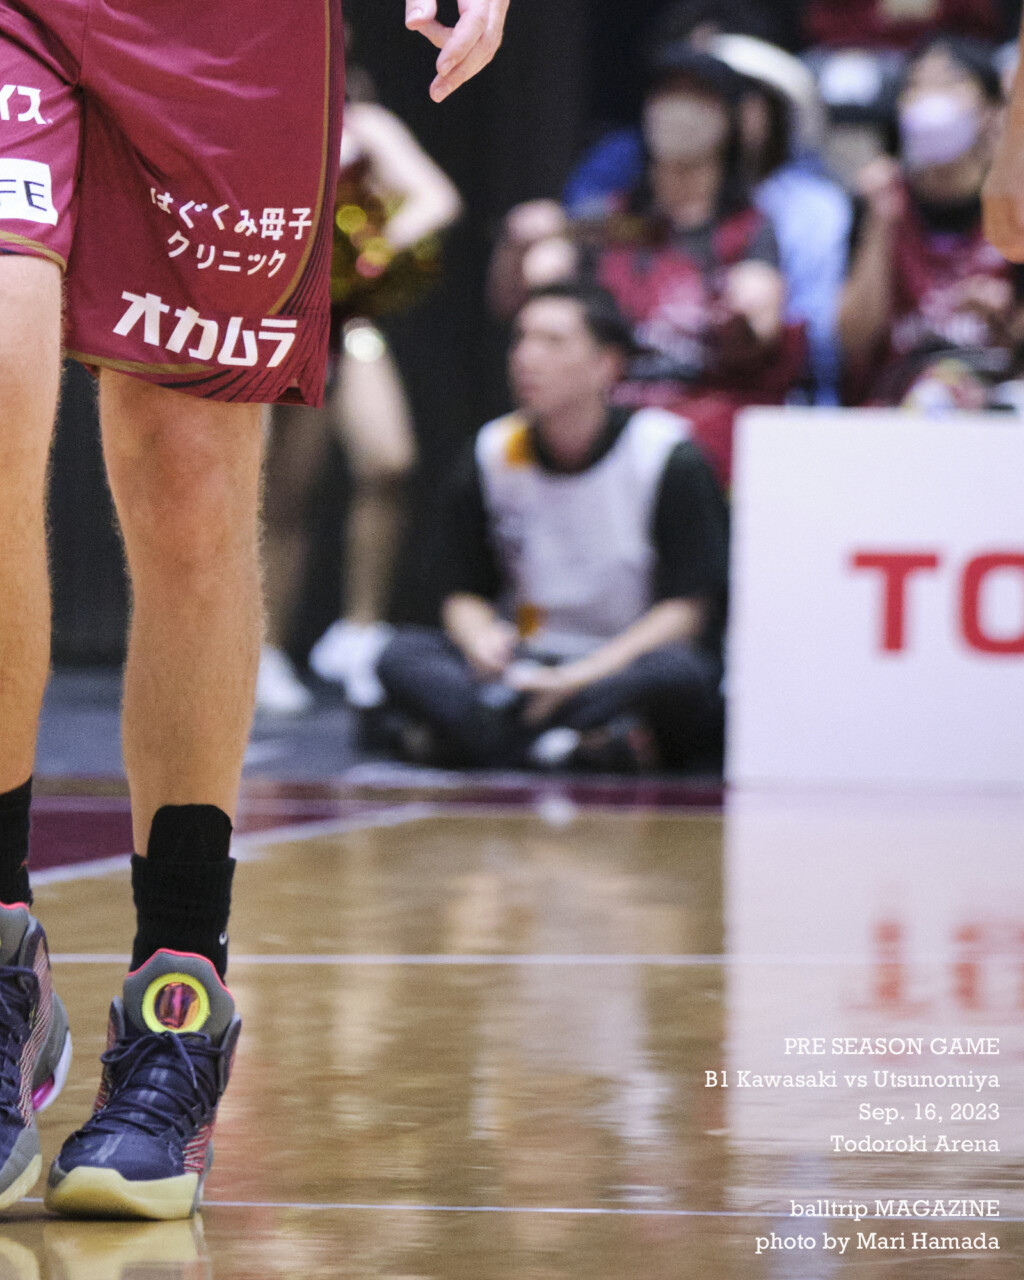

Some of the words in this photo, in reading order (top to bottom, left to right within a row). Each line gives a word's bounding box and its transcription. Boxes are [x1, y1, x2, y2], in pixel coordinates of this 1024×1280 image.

[150, 187, 312, 240] はぐくみ母子
[167, 230, 287, 278] クリニック
[112, 291, 297, 368] オカムラ
